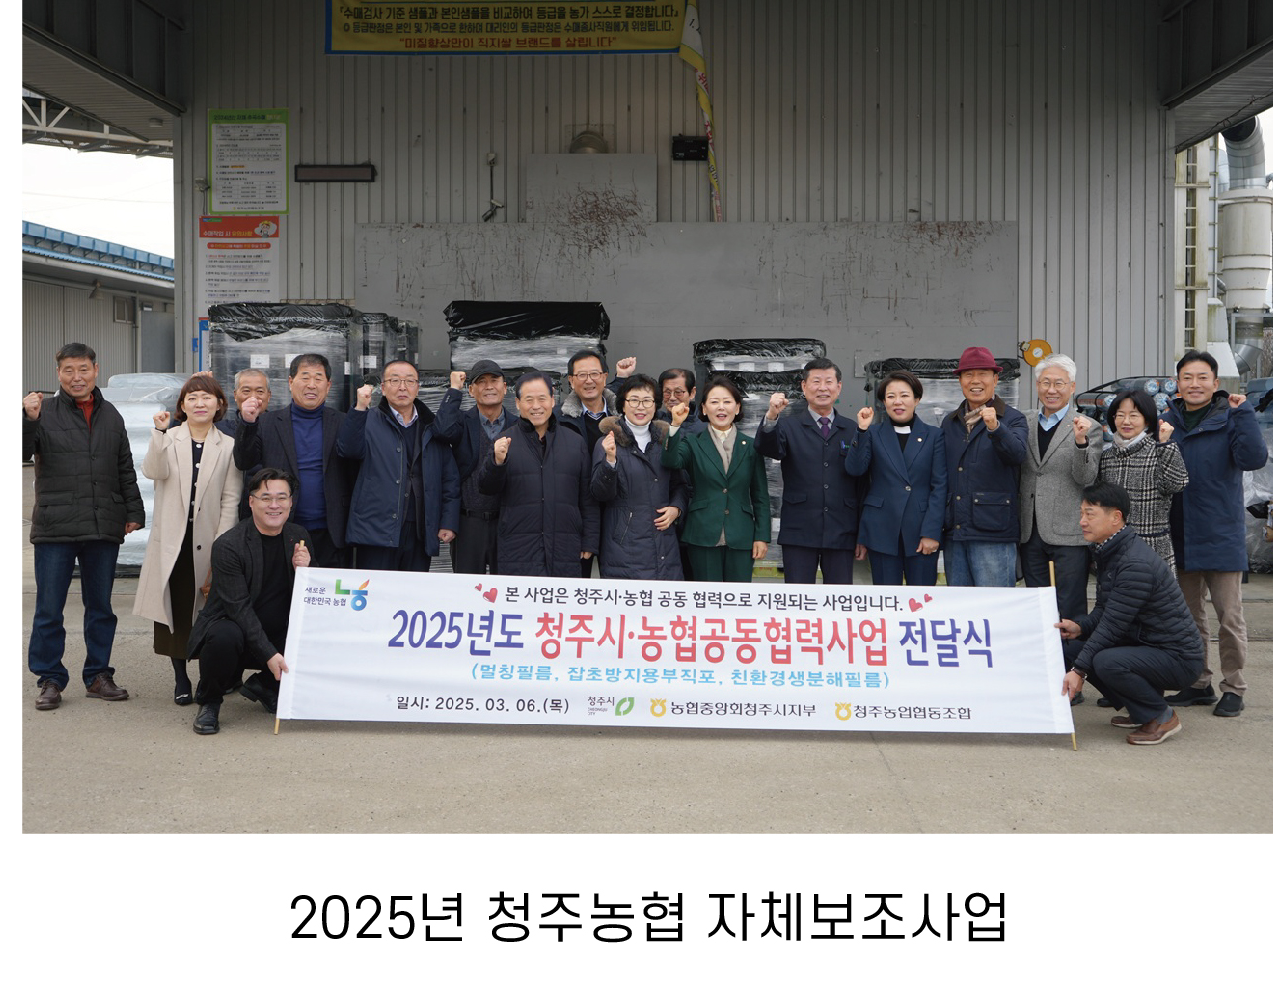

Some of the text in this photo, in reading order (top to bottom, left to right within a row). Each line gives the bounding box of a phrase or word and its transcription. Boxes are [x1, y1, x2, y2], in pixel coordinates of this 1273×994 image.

[386, 7, 405, 19] 기준
[409, 7, 438, 19] 샘플과
[441, 7, 489, 19] 본인샘플을
[493, 7, 533, 19] 비교하여
[537, 6, 566, 19] 등급을
[569, 6, 589, 18] 농가
[592, 6, 622, 18] 스스로
[353, 22, 393, 33] 등급판정은
[396, 22, 412, 33] 본인
[414, 22, 423, 33] 및
[425, 22, 456, 33] 가족으로
[486, 22, 518, 33] 대리인의
[521, 22, 561, 33] 등급판정은
[516, 37, 561, 48] 브랜드를
[305, 586, 327, 595] 새로운
[303, 596, 346, 607] 대한민국 농협
[505, 586, 903, 612] 본 사업은 청주시·농협 공동 협력으로 지원되는 사업입니다.
[388, 610, 993, 668] 2025년도 청주시·농협공동협력사업 전달식
[472, 663, 890, 689] (멀칭필름, 잡초방지용부직포, 친환경생분해필름)
[397, 696, 429, 711] 일시:
[435, 697, 480, 712] 2025.
[485, 698, 510, 713] 03.
[587, 696, 615, 706] 청주시
[671, 701, 817, 717] 농협중앙회청주시지부
[853, 704, 972, 720] 청주농업협동조합
